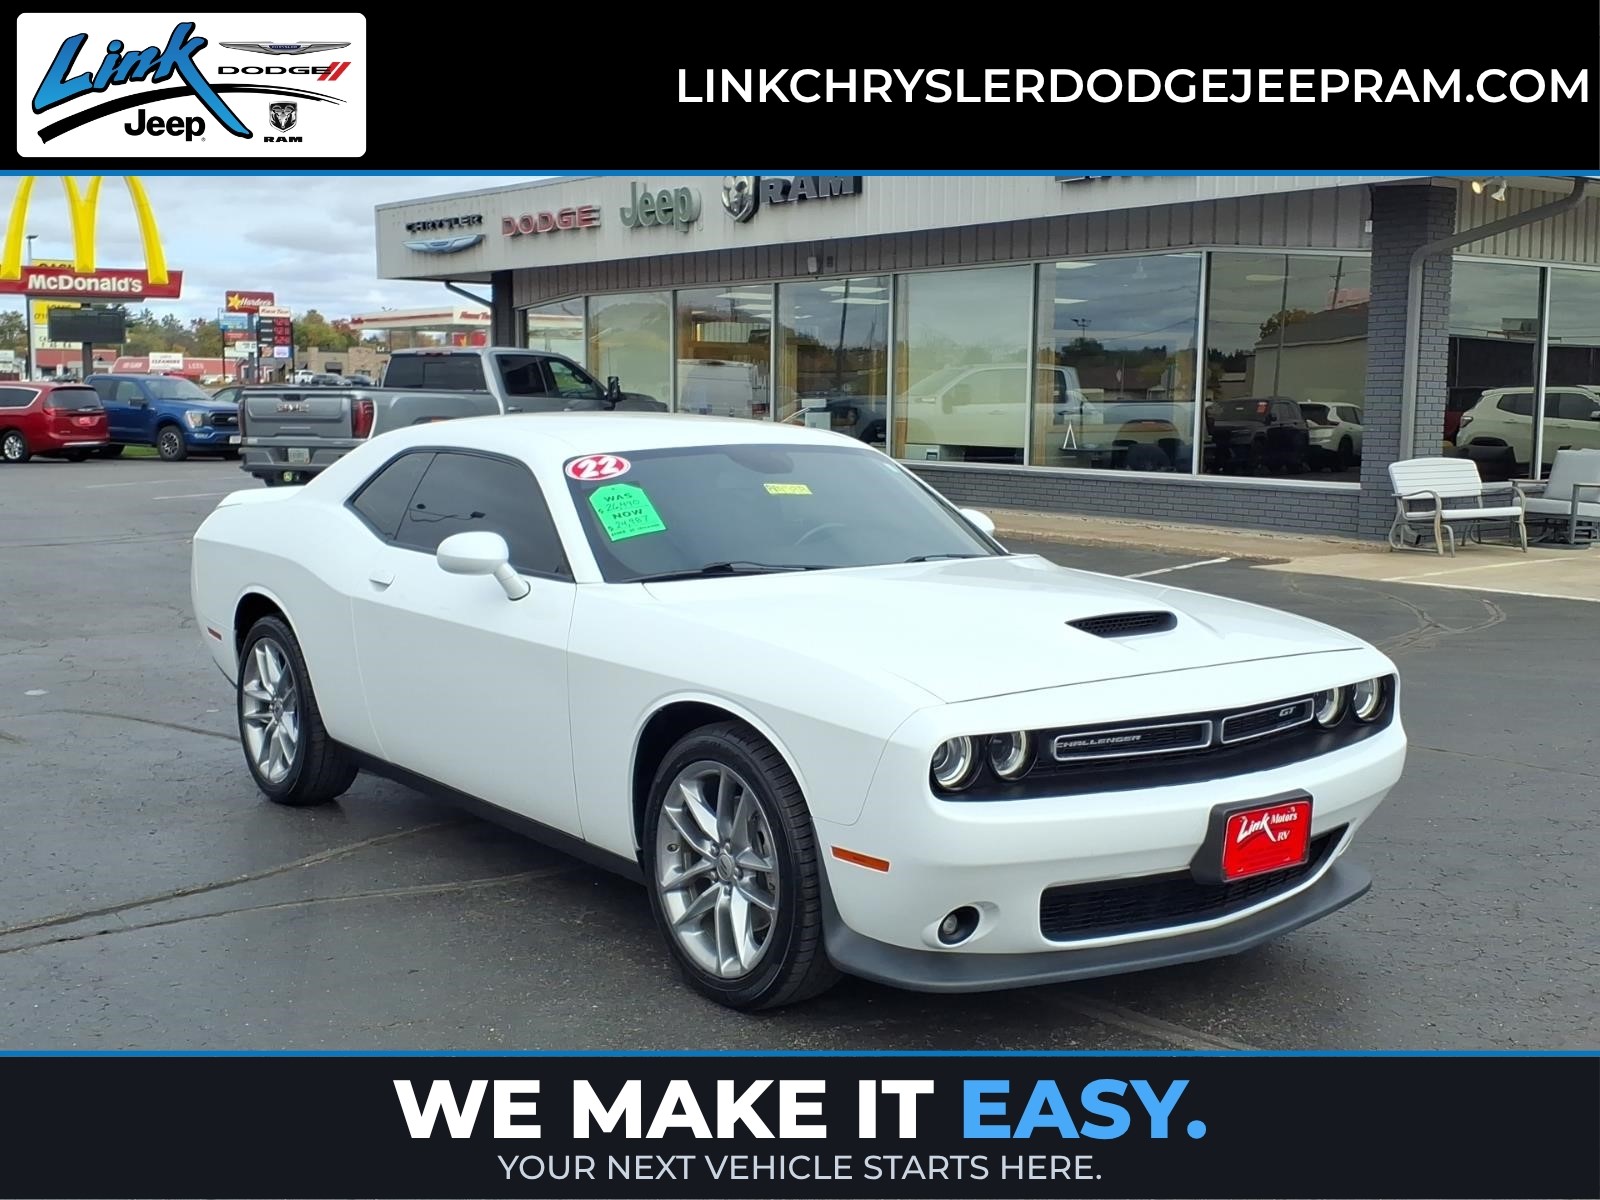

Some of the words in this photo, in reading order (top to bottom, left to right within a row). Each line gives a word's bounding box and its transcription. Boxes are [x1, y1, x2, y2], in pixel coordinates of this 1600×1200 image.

[761, 176, 862, 203] RAM
[619, 181, 700, 233] Jeep
[406, 214, 483, 234] CHRYSLER
[502, 205, 600, 236] DODGE
[28, 274, 143, 293] McDonald's
[577, 456, 620, 478] 22
[603, 493, 632, 502] WAS
[612, 508, 643, 519] NOW
[1280, 706, 1296, 716] GT
[1056, 735, 1142, 748] CHALLENGER
[1236, 812, 1277, 843] Link
[1277, 830, 1291, 842] RV
